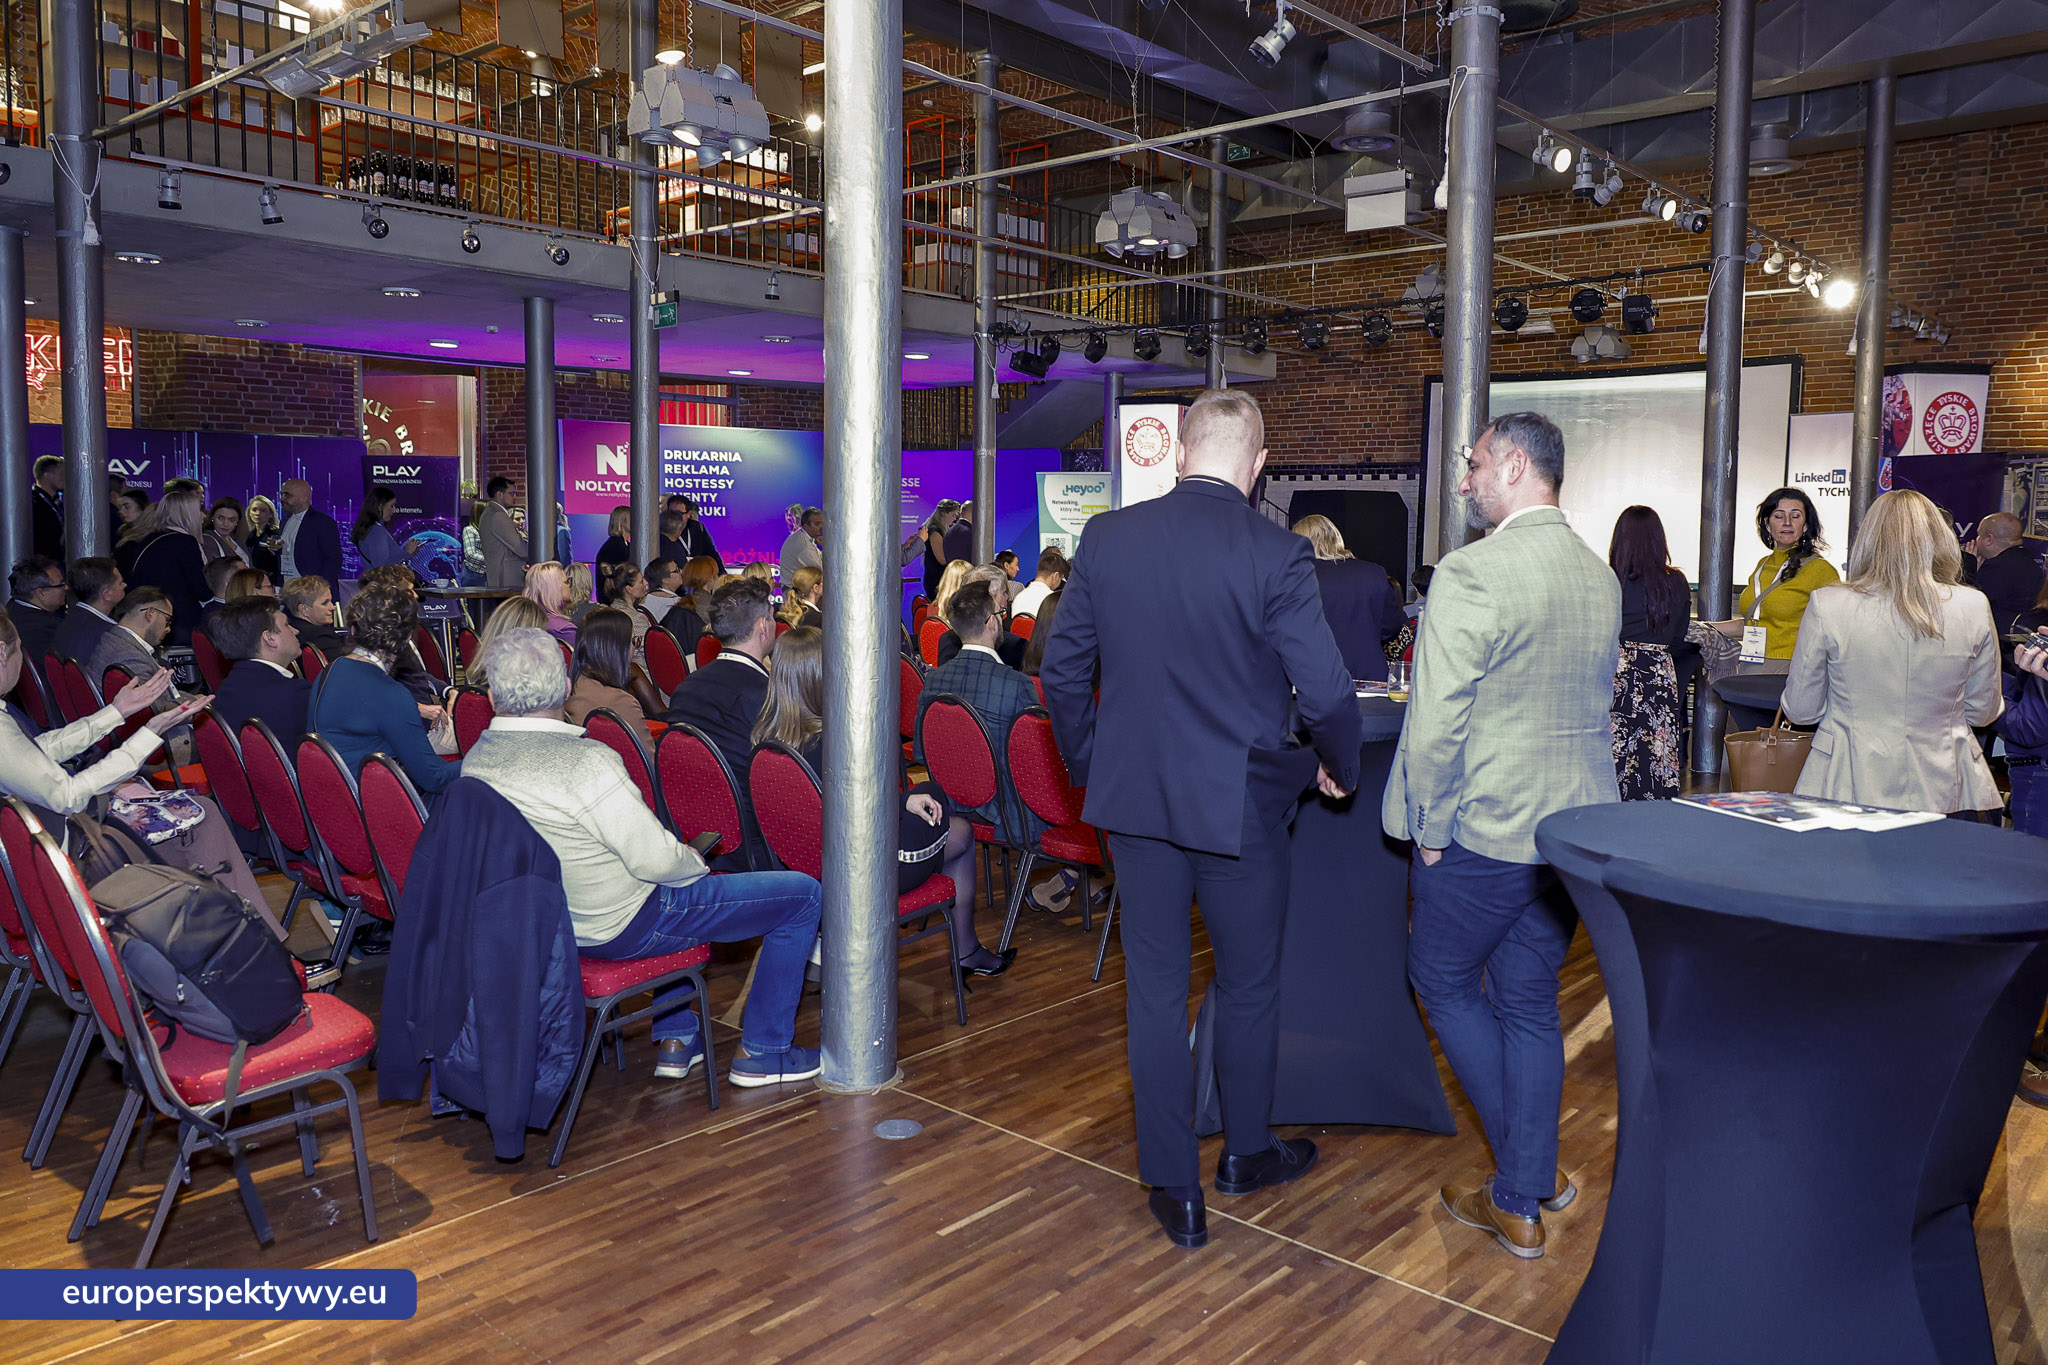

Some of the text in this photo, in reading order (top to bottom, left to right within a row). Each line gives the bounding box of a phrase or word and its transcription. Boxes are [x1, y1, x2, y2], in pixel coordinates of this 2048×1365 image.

[663, 449, 743, 463] DRUKARNIA
[372, 465, 422, 477] PLAY
[664, 464, 731, 476] REKLAMA
[664, 477, 735, 490] HOSTESSY
